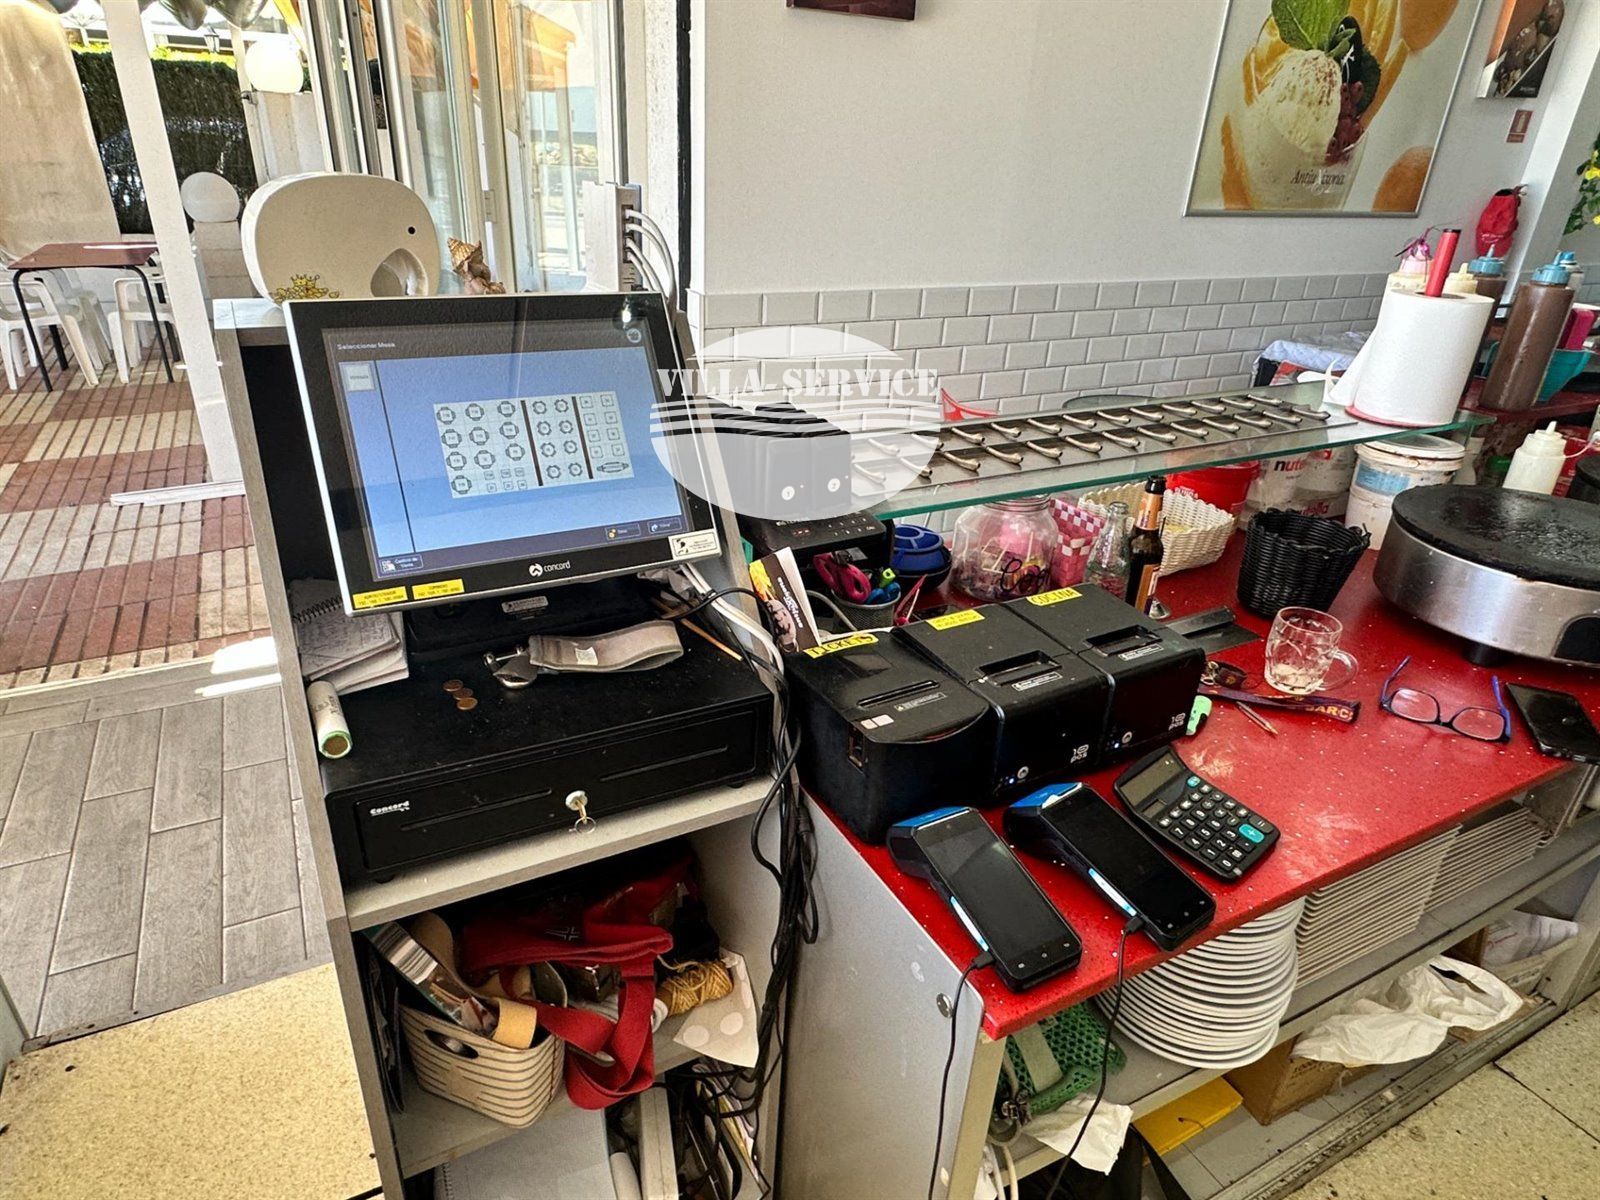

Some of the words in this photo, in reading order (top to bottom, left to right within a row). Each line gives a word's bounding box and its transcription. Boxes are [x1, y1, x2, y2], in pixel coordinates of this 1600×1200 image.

[543, 560, 572, 573] concord
[1030, 588, 1075, 604] COCINA
[808, 635, 874, 656] TICKETS
